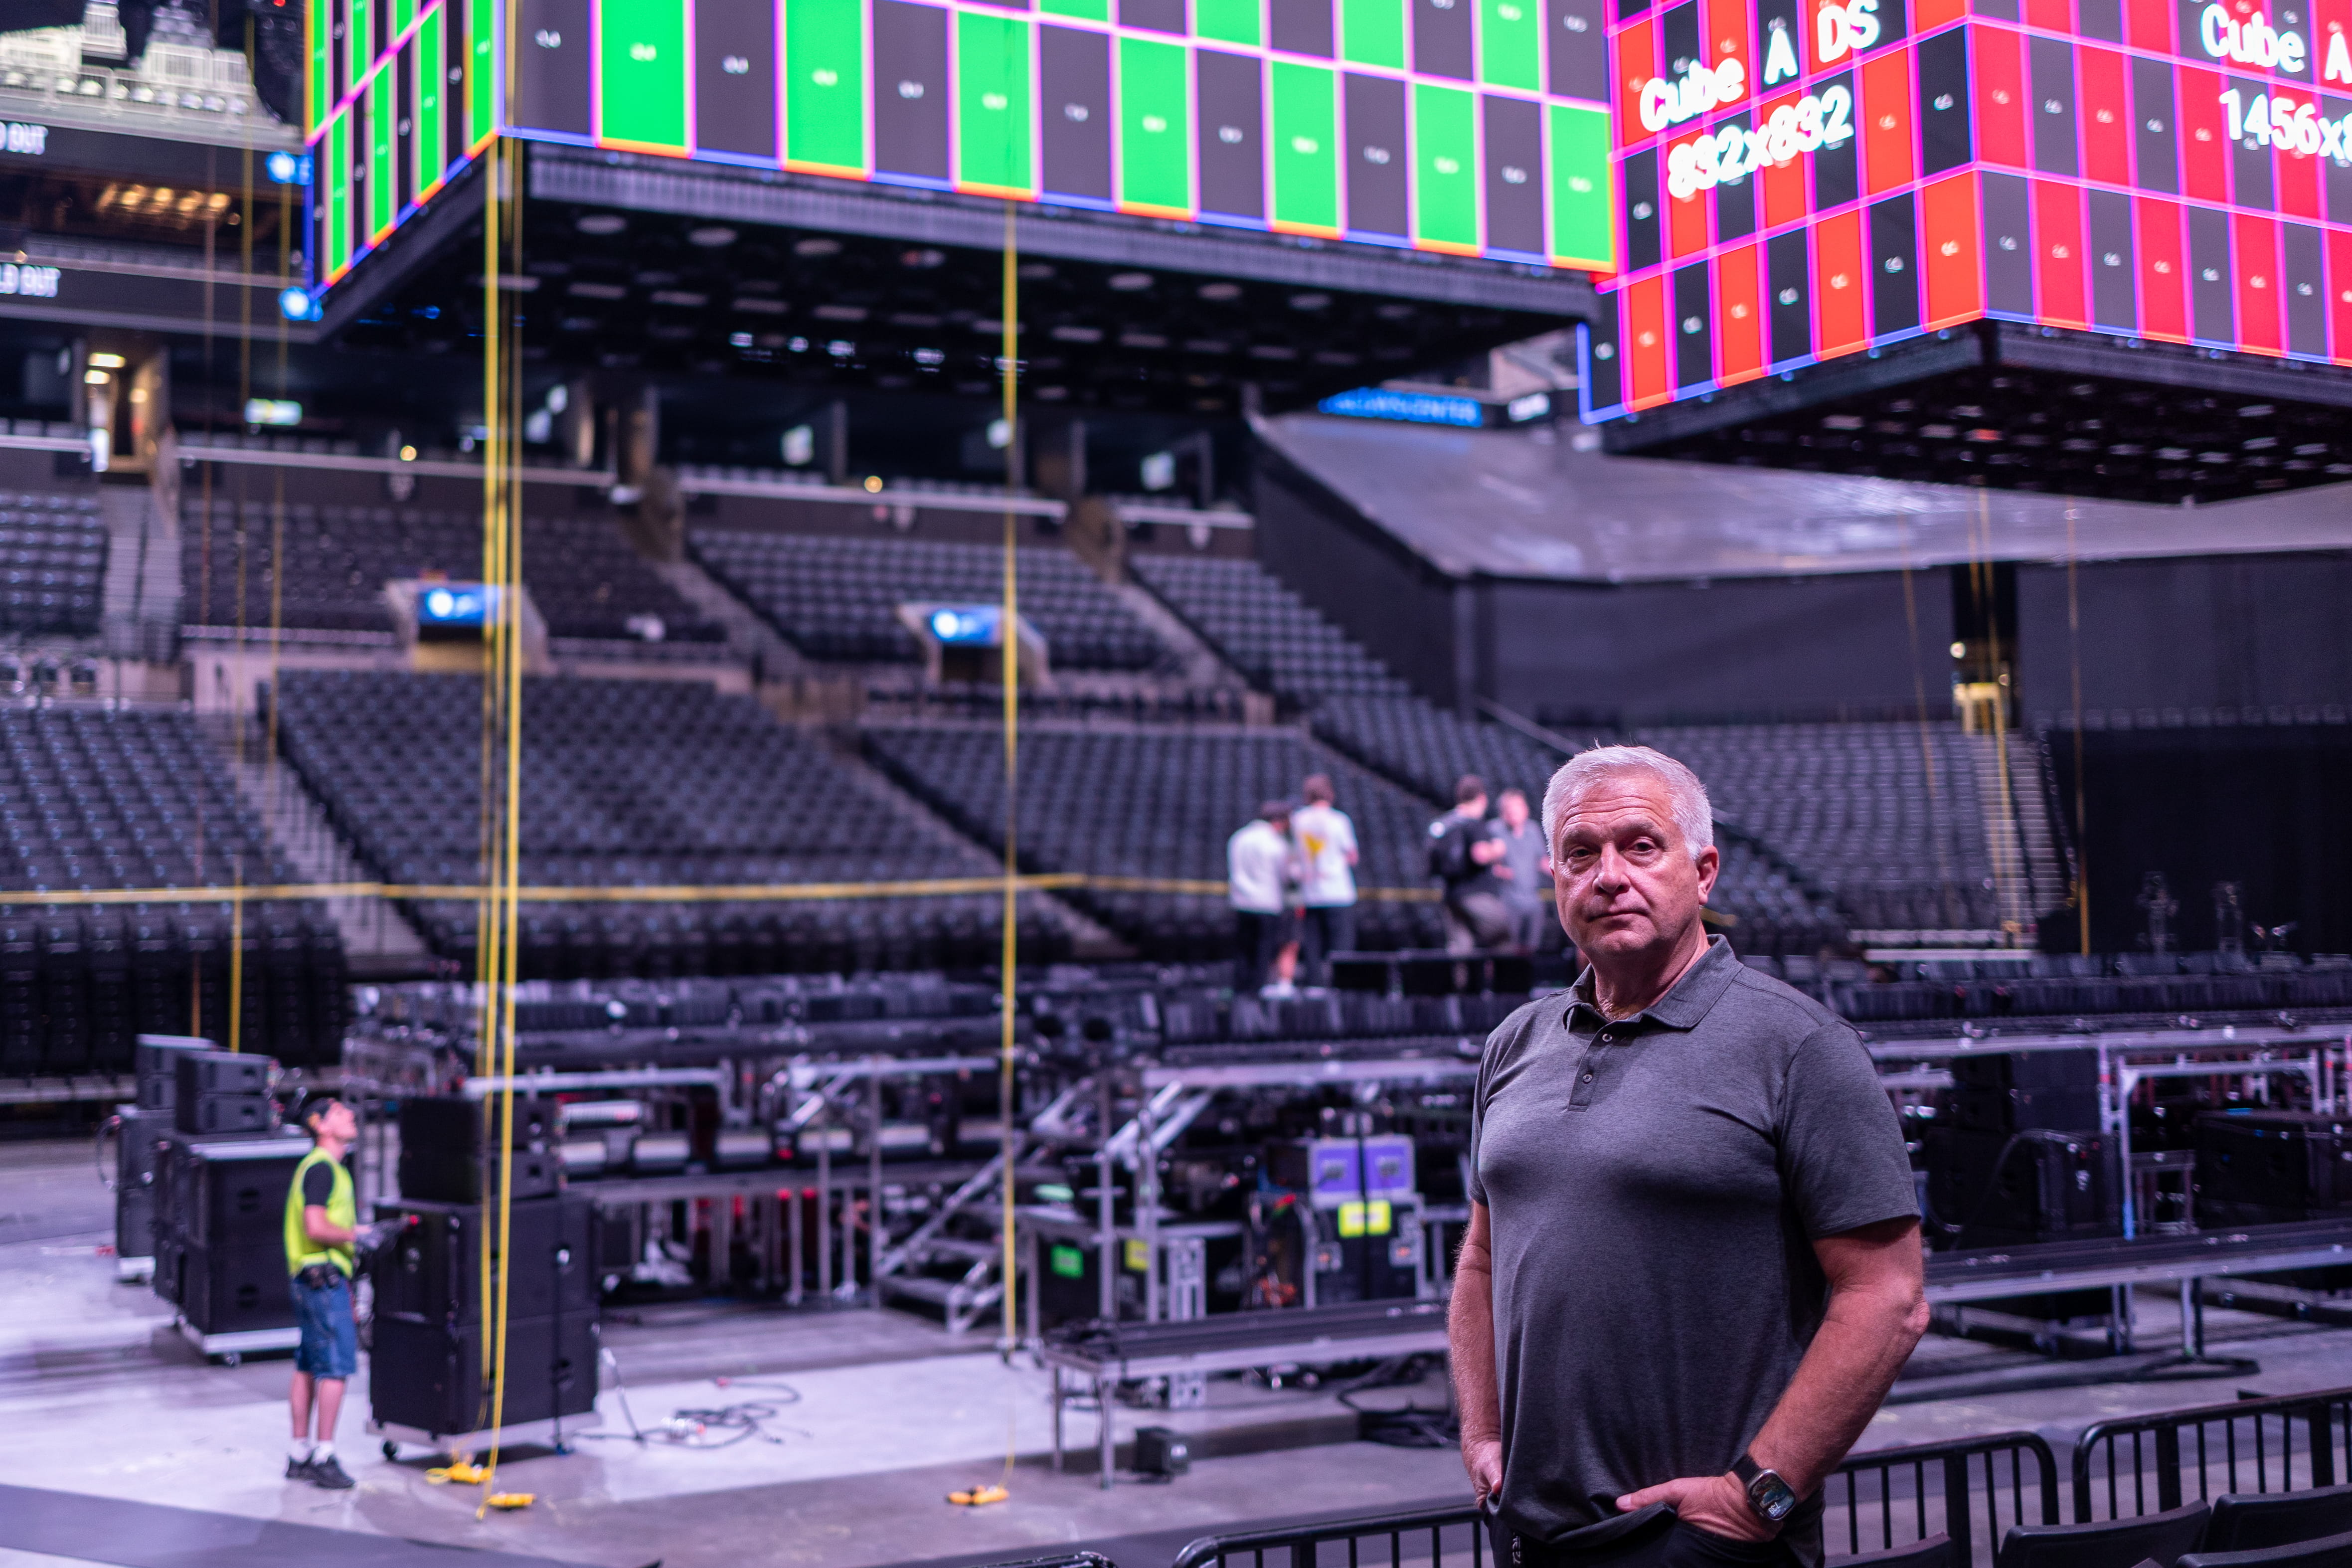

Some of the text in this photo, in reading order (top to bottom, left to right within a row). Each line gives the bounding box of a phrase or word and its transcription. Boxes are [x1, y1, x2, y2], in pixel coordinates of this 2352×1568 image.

[1640, 0, 1880, 132] Cube A DS
[2200, 3, 2352, 84] Cube A
[1668, 85, 1854, 198] 832x832
[1768, 1502, 1781, 1514] 7:39
